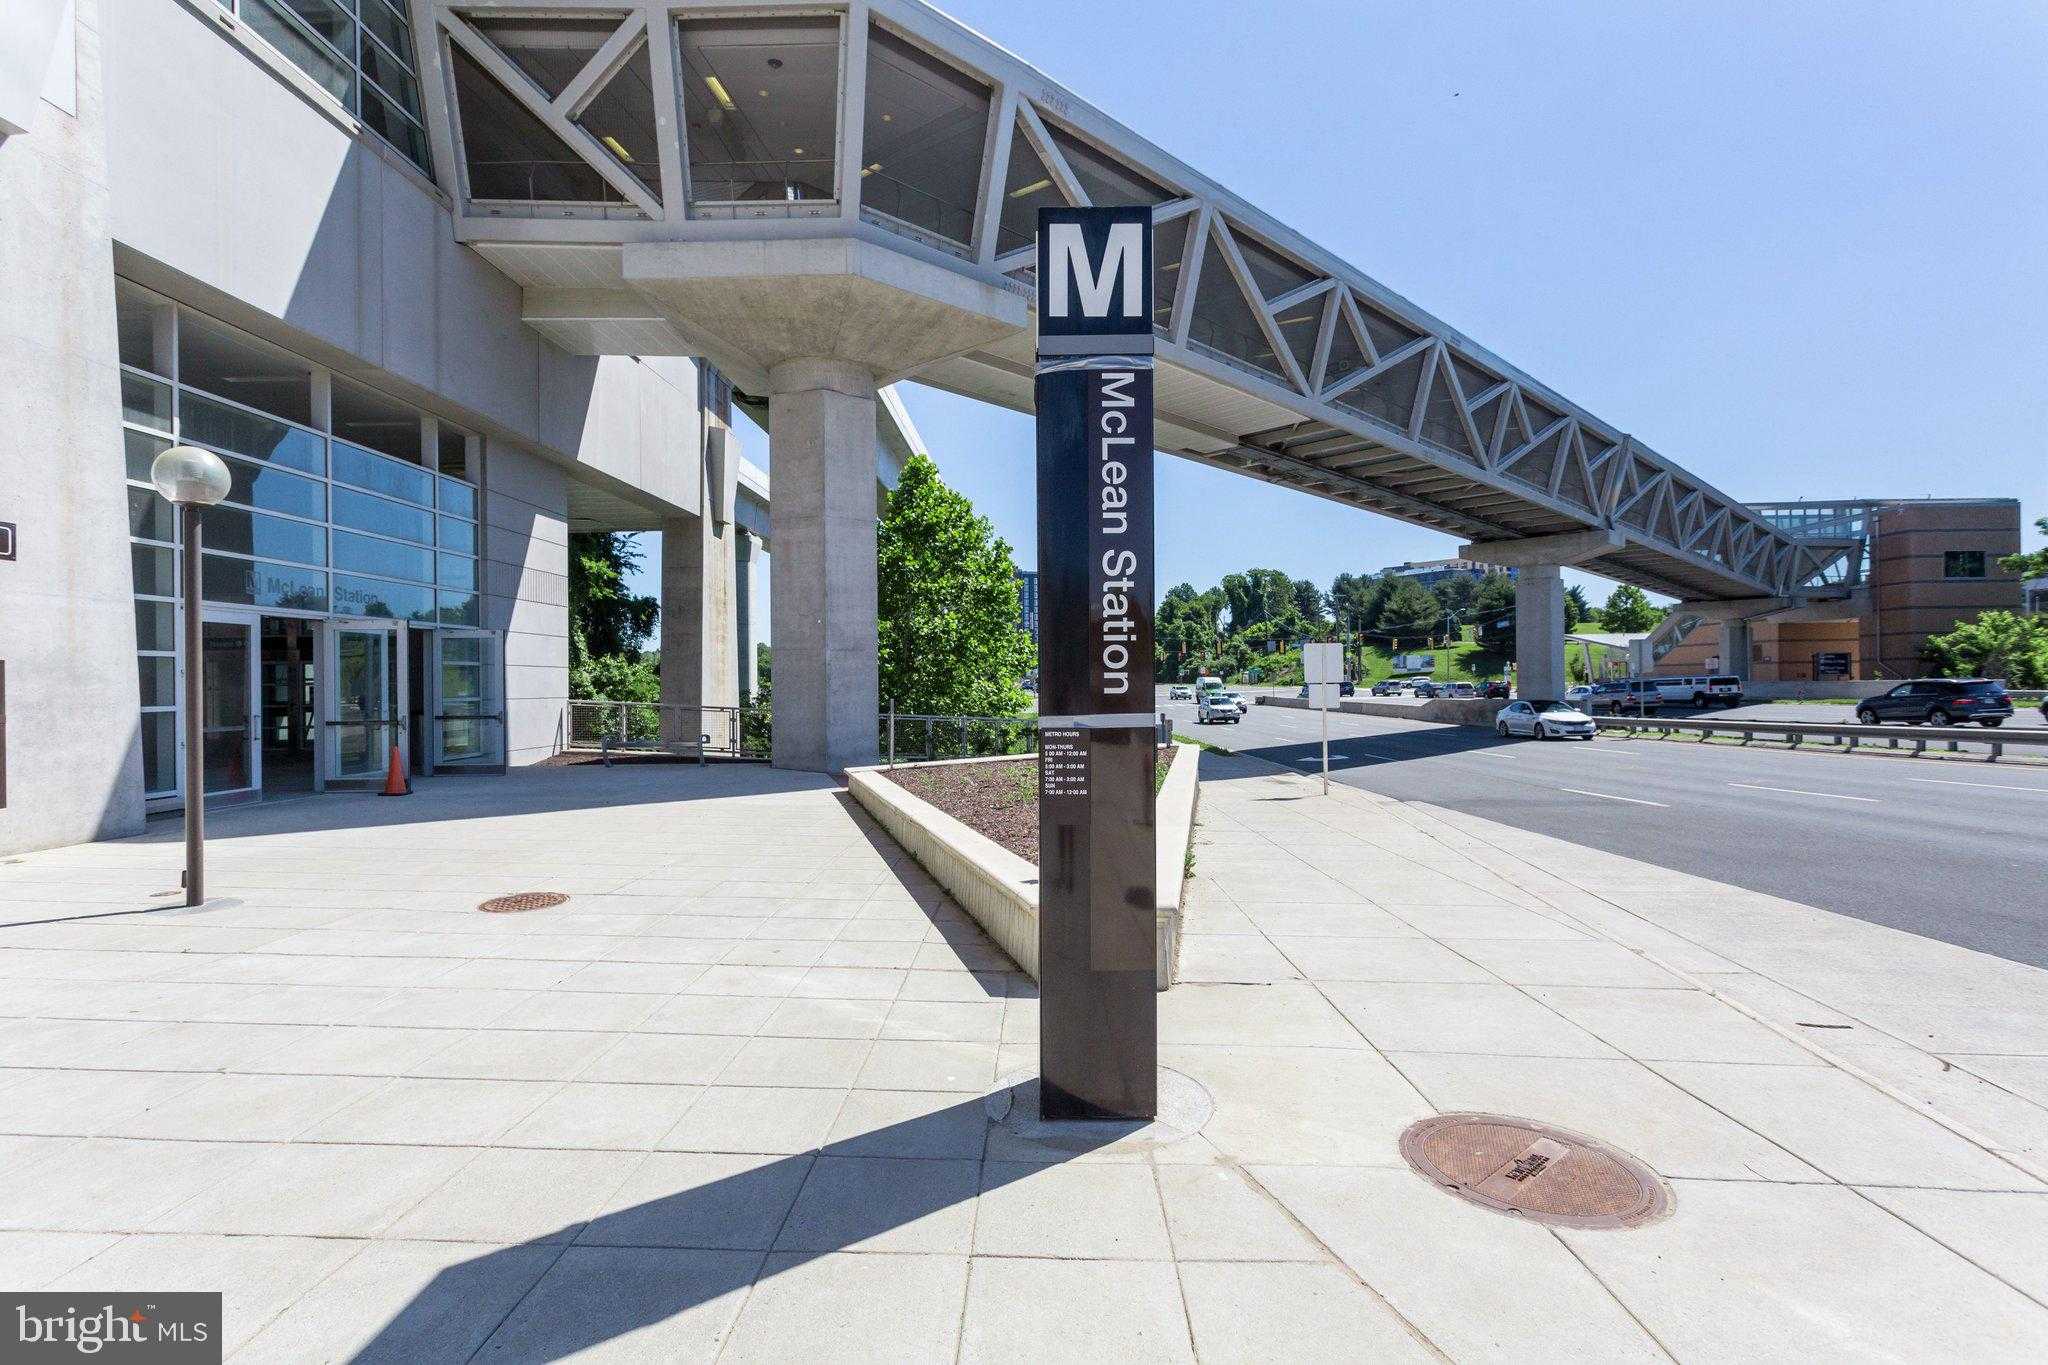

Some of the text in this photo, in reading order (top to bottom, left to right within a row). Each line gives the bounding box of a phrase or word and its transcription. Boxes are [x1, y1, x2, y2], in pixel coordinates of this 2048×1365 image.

[1049, 223, 1142, 317] M
[1101, 372, 1138, 694] McLean Station
[335, 584, 379, 604] Station
